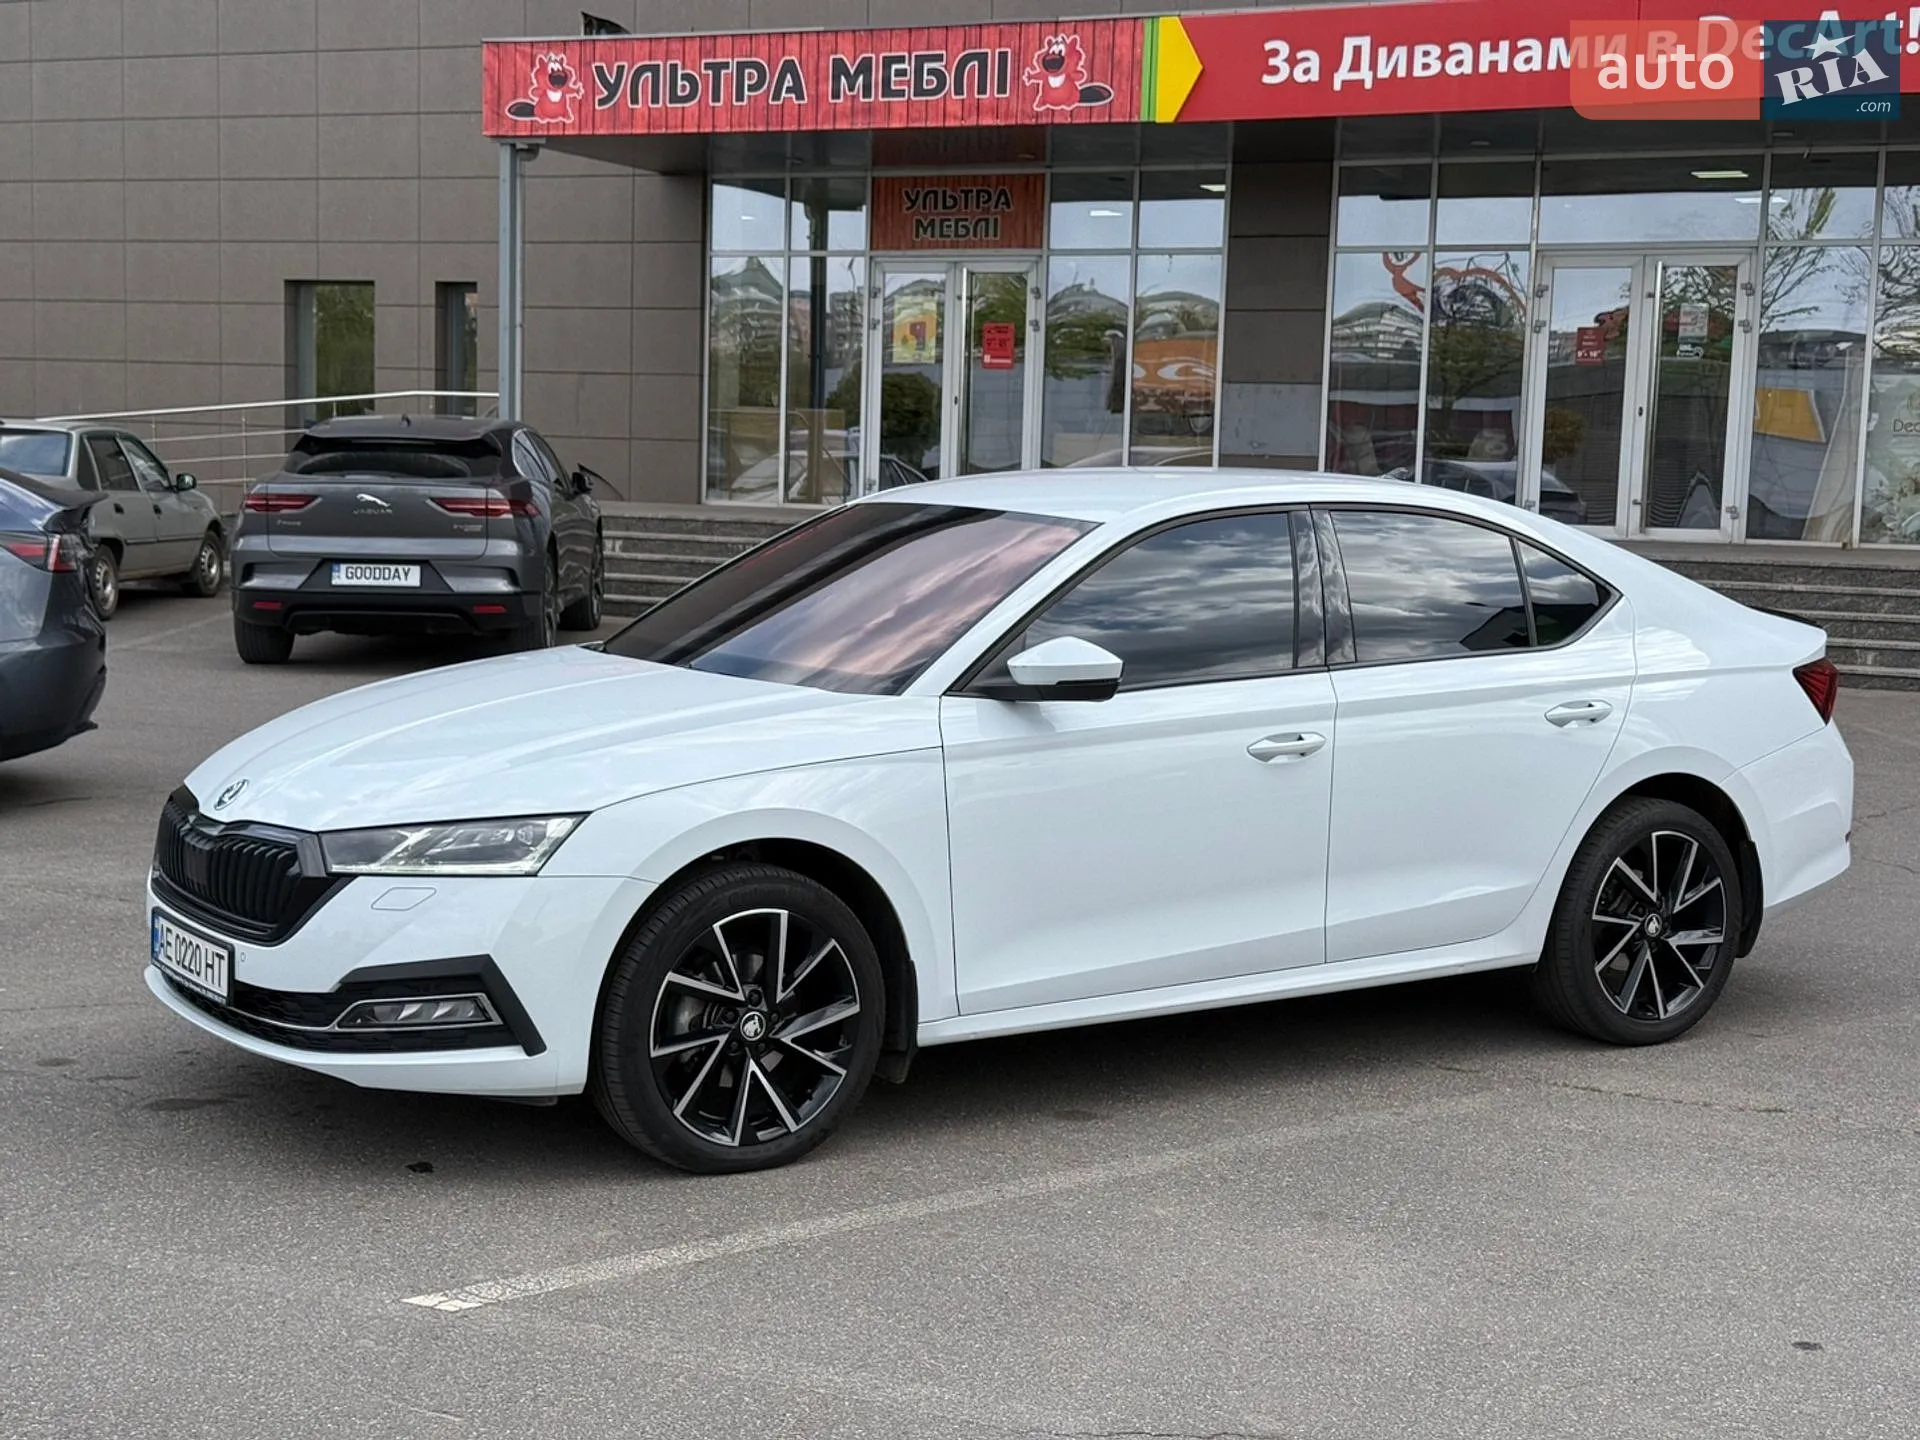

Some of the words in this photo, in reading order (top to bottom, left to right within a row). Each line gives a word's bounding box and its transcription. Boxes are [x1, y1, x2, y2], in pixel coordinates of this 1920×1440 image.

[593, 56, 807, 109] УЛЬТРА
[830, 48, 1010, 102] МЕБЛІ
[1260, 39, 1321, 86] За
[1333, 34, 1628, 91] Диванами
[1645, 29, 1679, 65] в
[903, 187, 1014, 213] УЛЬТРА
[913, 215, 1001, 241] МЕБЛІ
[345, 566, 411, 581] GOODDAY
[160, 923, 173, 962] AE
[175, 933, 202, 977] 0220
[205, 947, 225, 988] HT
